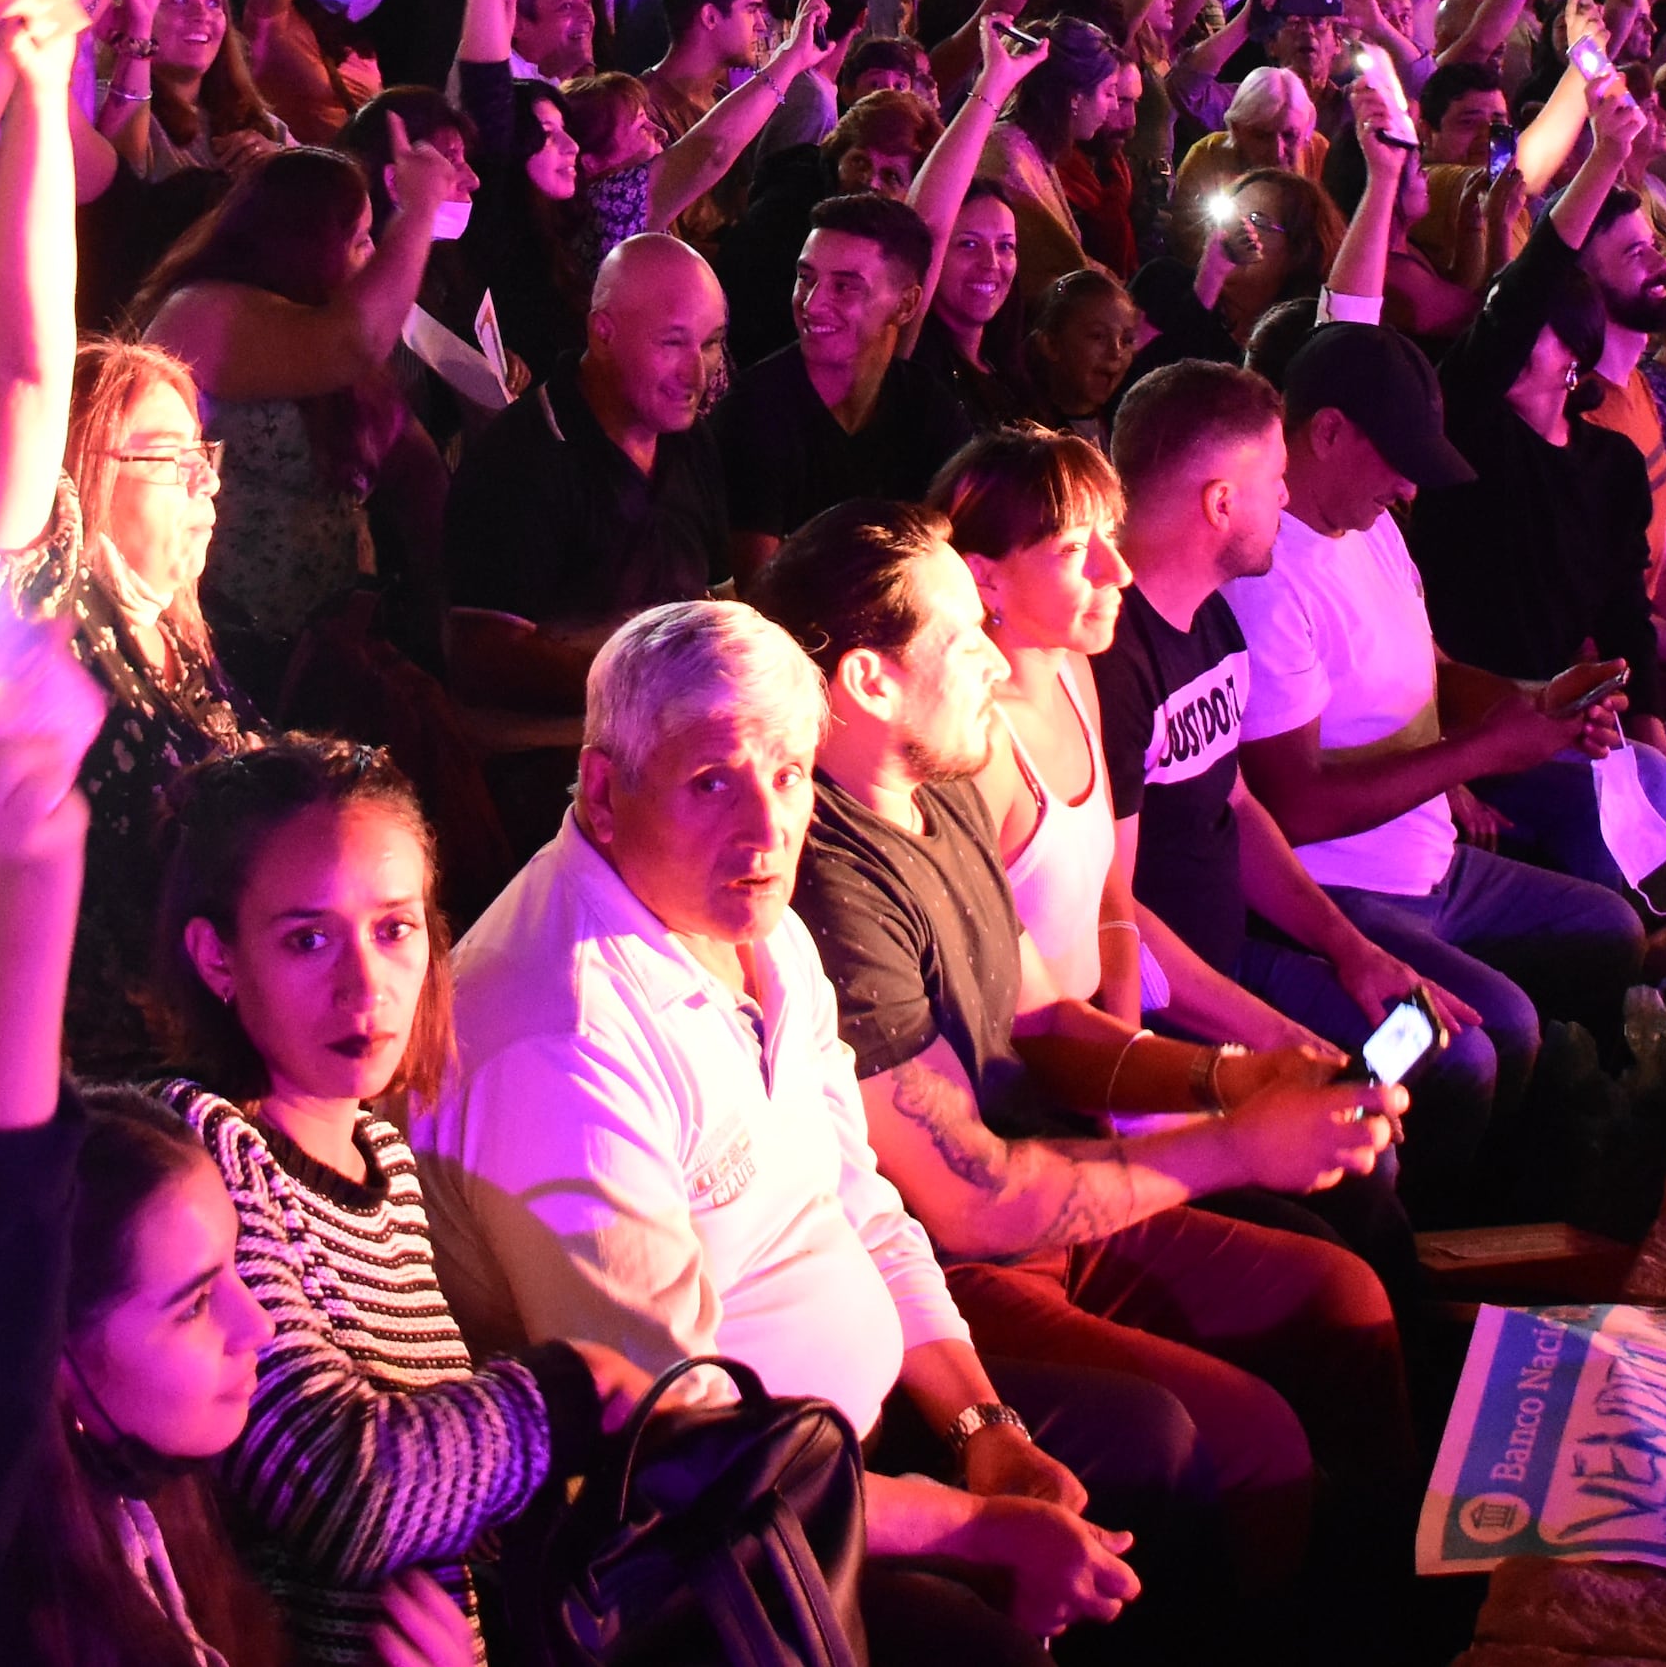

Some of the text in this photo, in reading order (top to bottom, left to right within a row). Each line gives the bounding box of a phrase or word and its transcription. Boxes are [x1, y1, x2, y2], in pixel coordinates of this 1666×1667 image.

[1158, 674, 1241, 767] JUST DO IT
[712, 1156, 757, 1208] CLUB
[1490, 1320, 1567, 1483] Banco Naci
